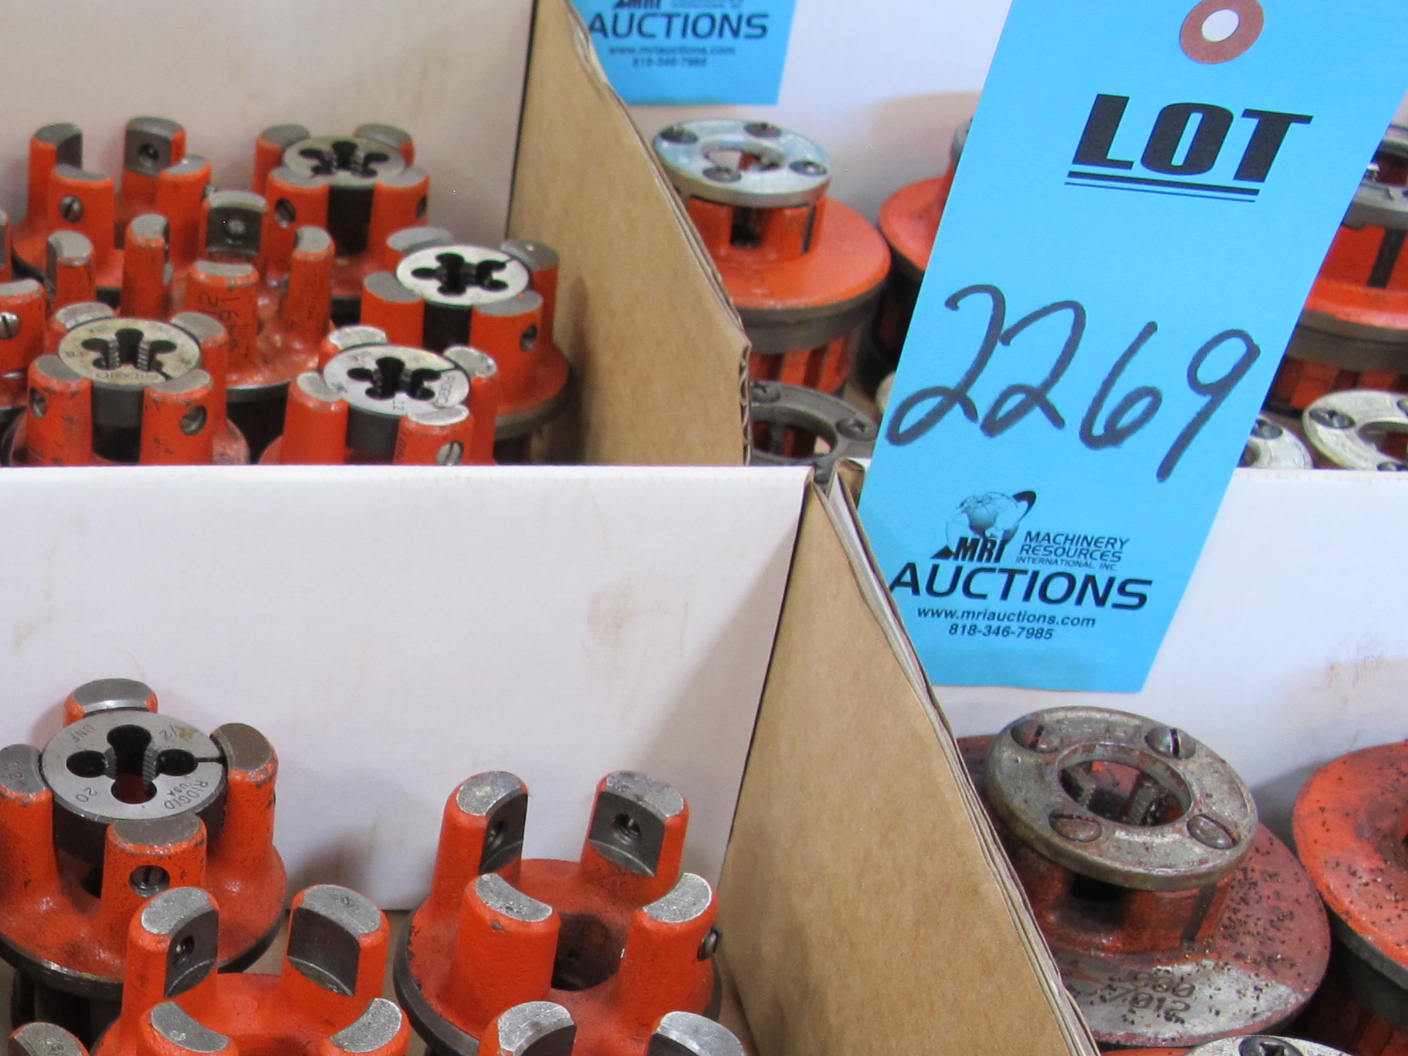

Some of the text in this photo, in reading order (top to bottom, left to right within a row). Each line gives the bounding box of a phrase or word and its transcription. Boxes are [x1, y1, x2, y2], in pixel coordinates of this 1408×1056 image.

[588, 12, 769, 40] AUCTIONS
[1072, 93, 1313, 181] LOT
[885, 284, 1261, 482] 2269
[953, 536, 1007, 564] MRI
[1020, 544, 1122, 562] RESOURCES
[1024, 530, 1130, 550] MACHINERY
[889, 562, 1153, 611] AUCTIONS
[917, 606, 1095, 628] www.mriauctions.com
[949, 623, 1053, 640] 818-346-7985
[164, 780, 209, 811] RIDGID
[166, 784, 190, 797] USA
